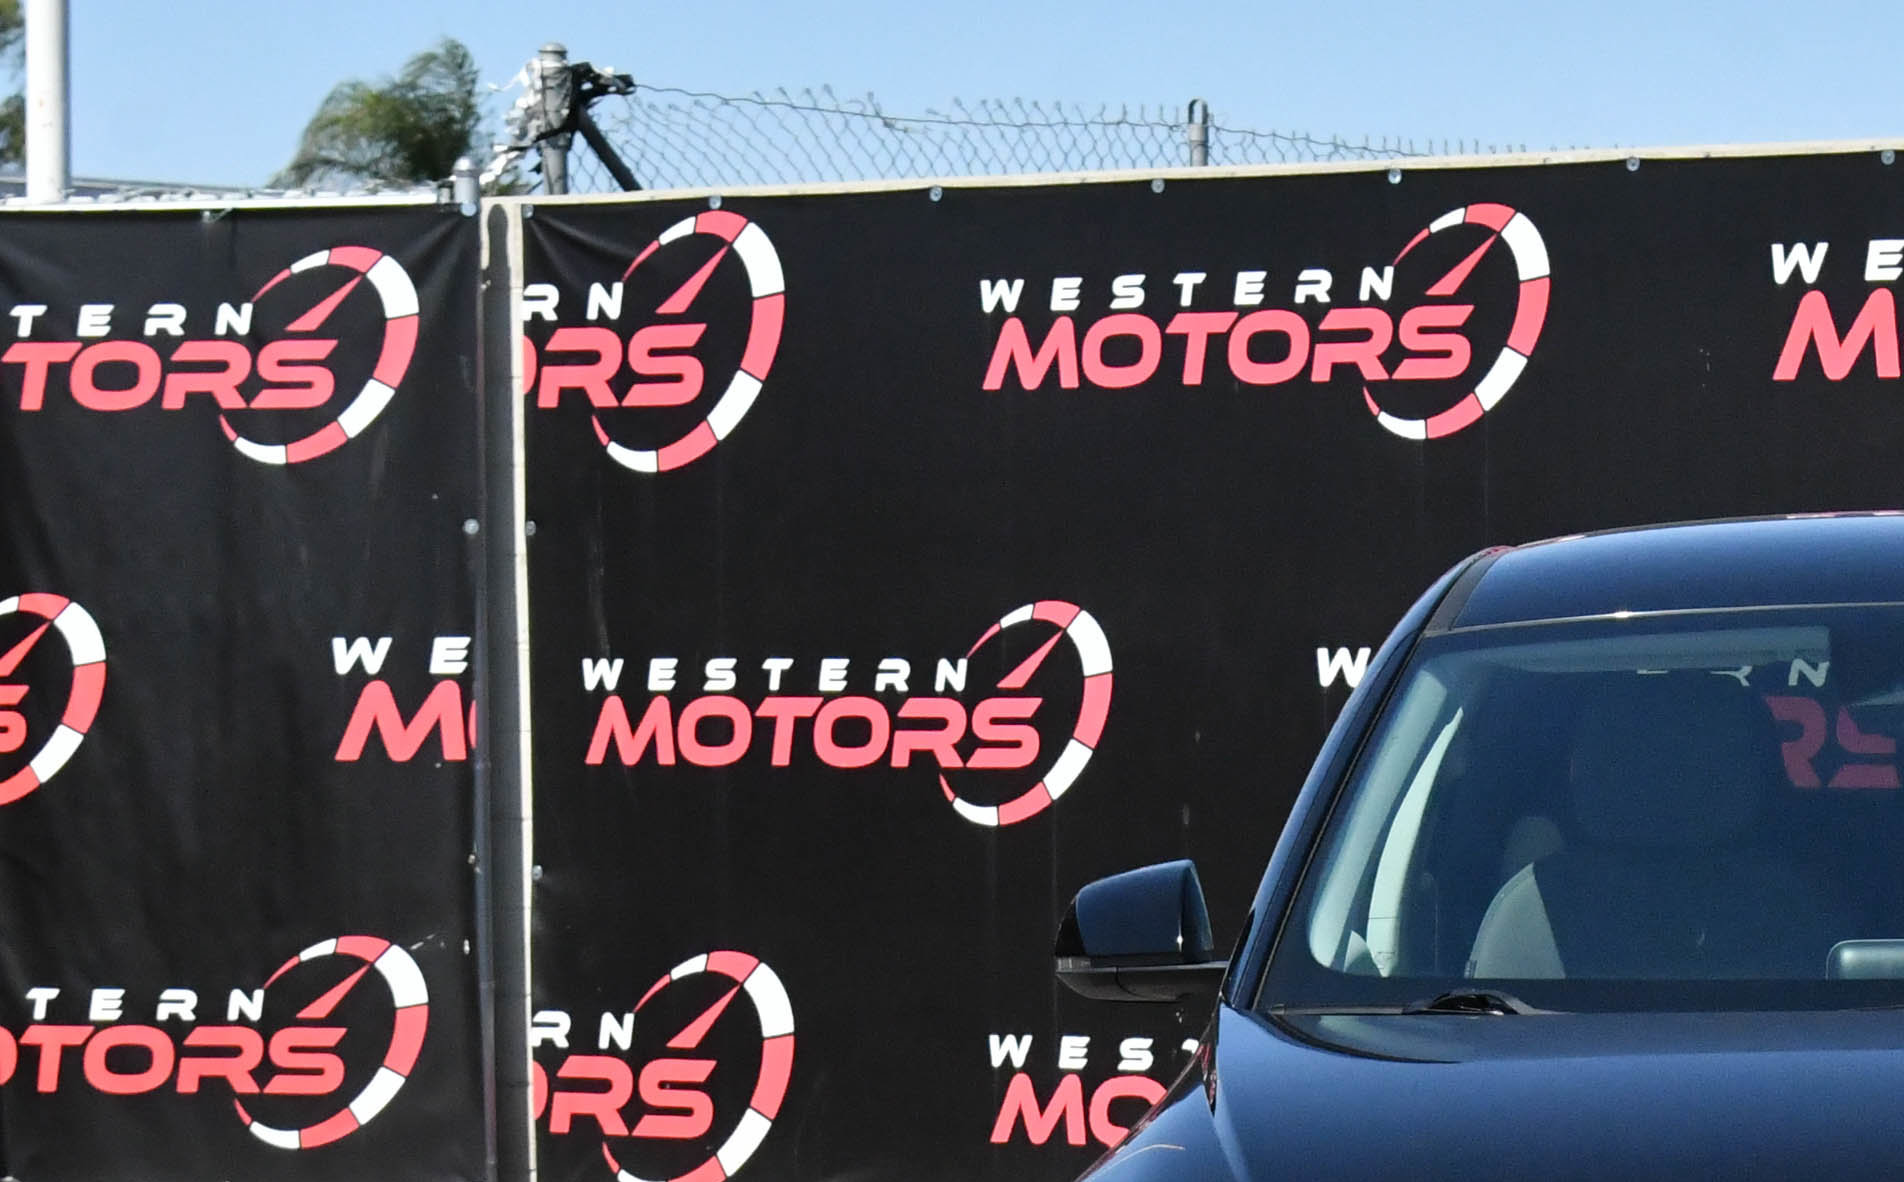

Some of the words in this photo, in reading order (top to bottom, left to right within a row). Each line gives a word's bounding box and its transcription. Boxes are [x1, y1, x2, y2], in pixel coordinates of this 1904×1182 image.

[980, 265, 1394, 313] WESTERN
[9, 303, 252, 337] TERN
[982, 304, 1475, 391] MOTORS
[1, 340, 339, 411] TORS
[523, 323, 708, 409] RS
[331, 636, 472, 676] WE
[582, 657, 968, 692] WESTERN
[1316, 647, 1371, 688] W
[335, 679, 478, 763] M
[585, 695, 1043, 769] MOTORS
[25, 987, 265, 1022] TERN
[0, 1024, 348, 1095] TORS
[988, 1033, 1200, 1072] WES
[531, 1054, 718, 1139] RS
